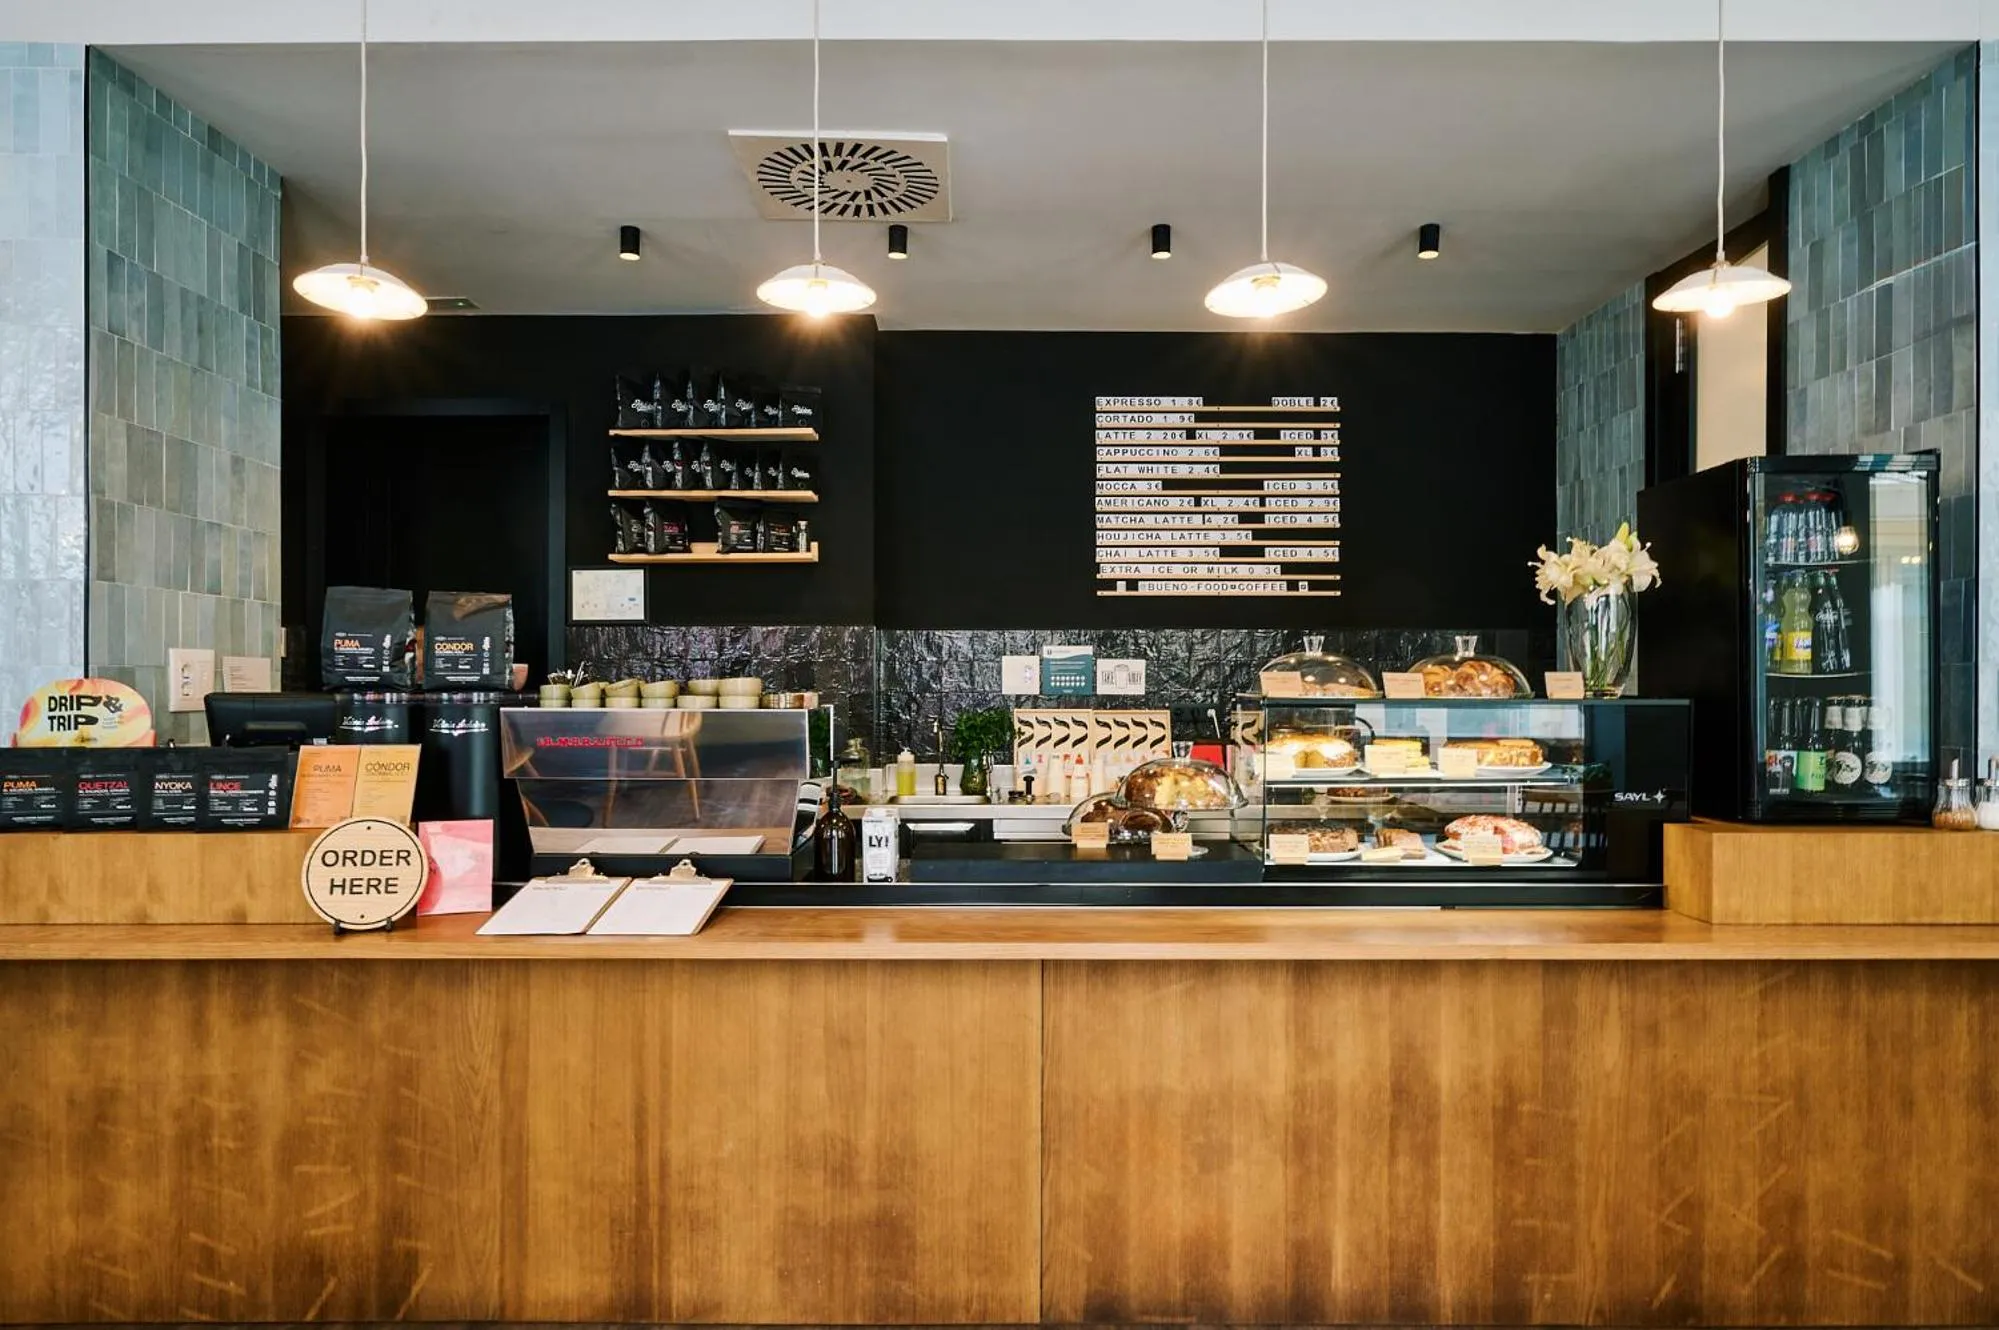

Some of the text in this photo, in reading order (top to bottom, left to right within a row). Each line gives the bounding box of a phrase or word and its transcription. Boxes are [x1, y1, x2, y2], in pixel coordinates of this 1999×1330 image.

[1273, 399, 1313, 407] DOBLE
[1322, 399, 1336, 407] 2€
[1097, 415, 1153, 423] CORTADO
[1097, 432, 1135, 440] LATTE
[1197, 432, 1211, 440] XL
[1283, 432, 1313, 440] ICED
[1322, 432, 1337, 440] 3€
[1098, 466, 1128, 474] FLAT
[1138, 466, 1177, 474] WHITE
[1266, 482, 1296, 490] ICED
[1097, 499, 1169, 507] AMERICANO
[1179, 499, 1193, 507] 2€
[1202, 499, 1216, 507] XL
[1097, 516, 1145, 524] MATCHA
[1155, 516, 1193, 524] LATTE
[1268, 516, 1297, 524] ICED
[1101, 566, 1141, 574] EXTRA
[1152, 566, 1173, 574] ICE
[1183, 566, 1197, 574] OR
[1207, 566, 1238, 574] MILK
[1238, 583, 1286, 591] COFFEE
[334, 640, 360, 648] PUMA
[48, 695, 102, 712] DRIP
[48, 715, 99, 732] TRIP
[154, 781, 192, 789] NYOKA
[1614, 792, 1652, 801] SAYL
[321, 848, 411, 867] ORDER
[329, 878, 399, 895] HERE
